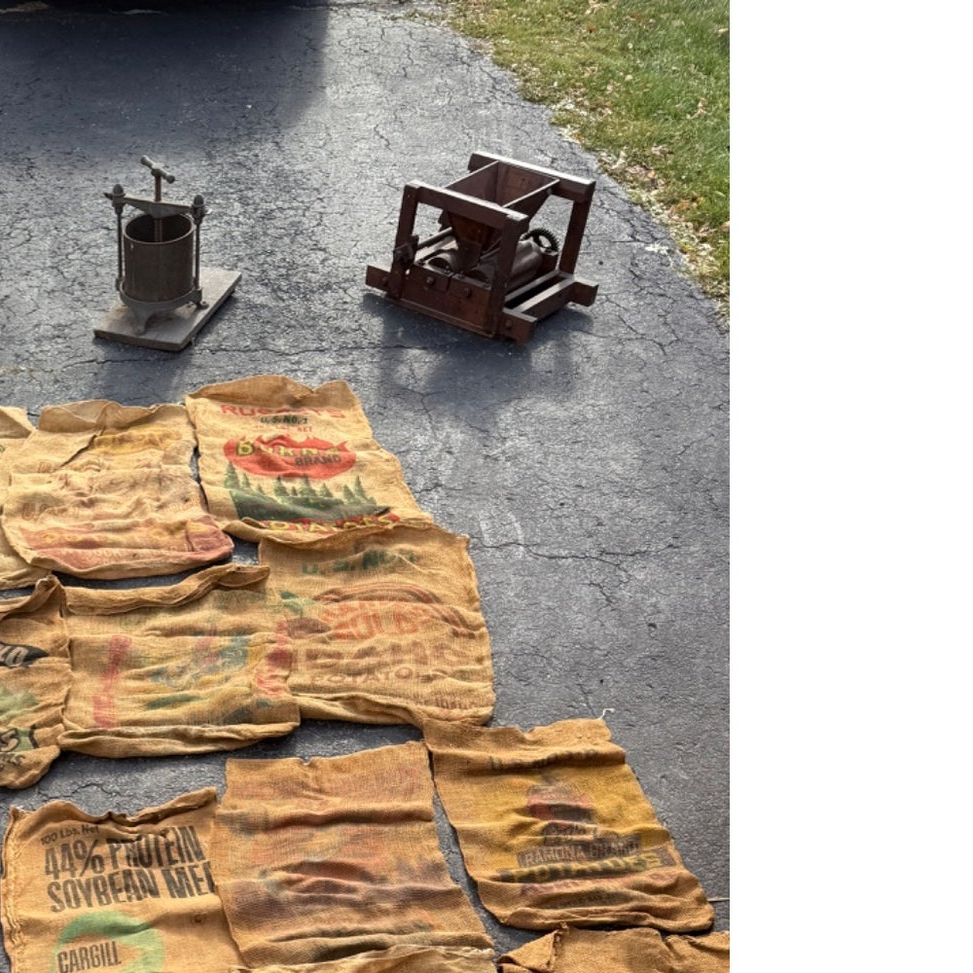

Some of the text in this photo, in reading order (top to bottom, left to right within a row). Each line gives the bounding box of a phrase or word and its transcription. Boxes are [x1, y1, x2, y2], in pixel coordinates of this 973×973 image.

[41, 825, 100, 846] 100 Lbs. Net
[45, 826, 206, 880] 44% PROTEIN
[47, 868, 161, 913] SOYBEAN
